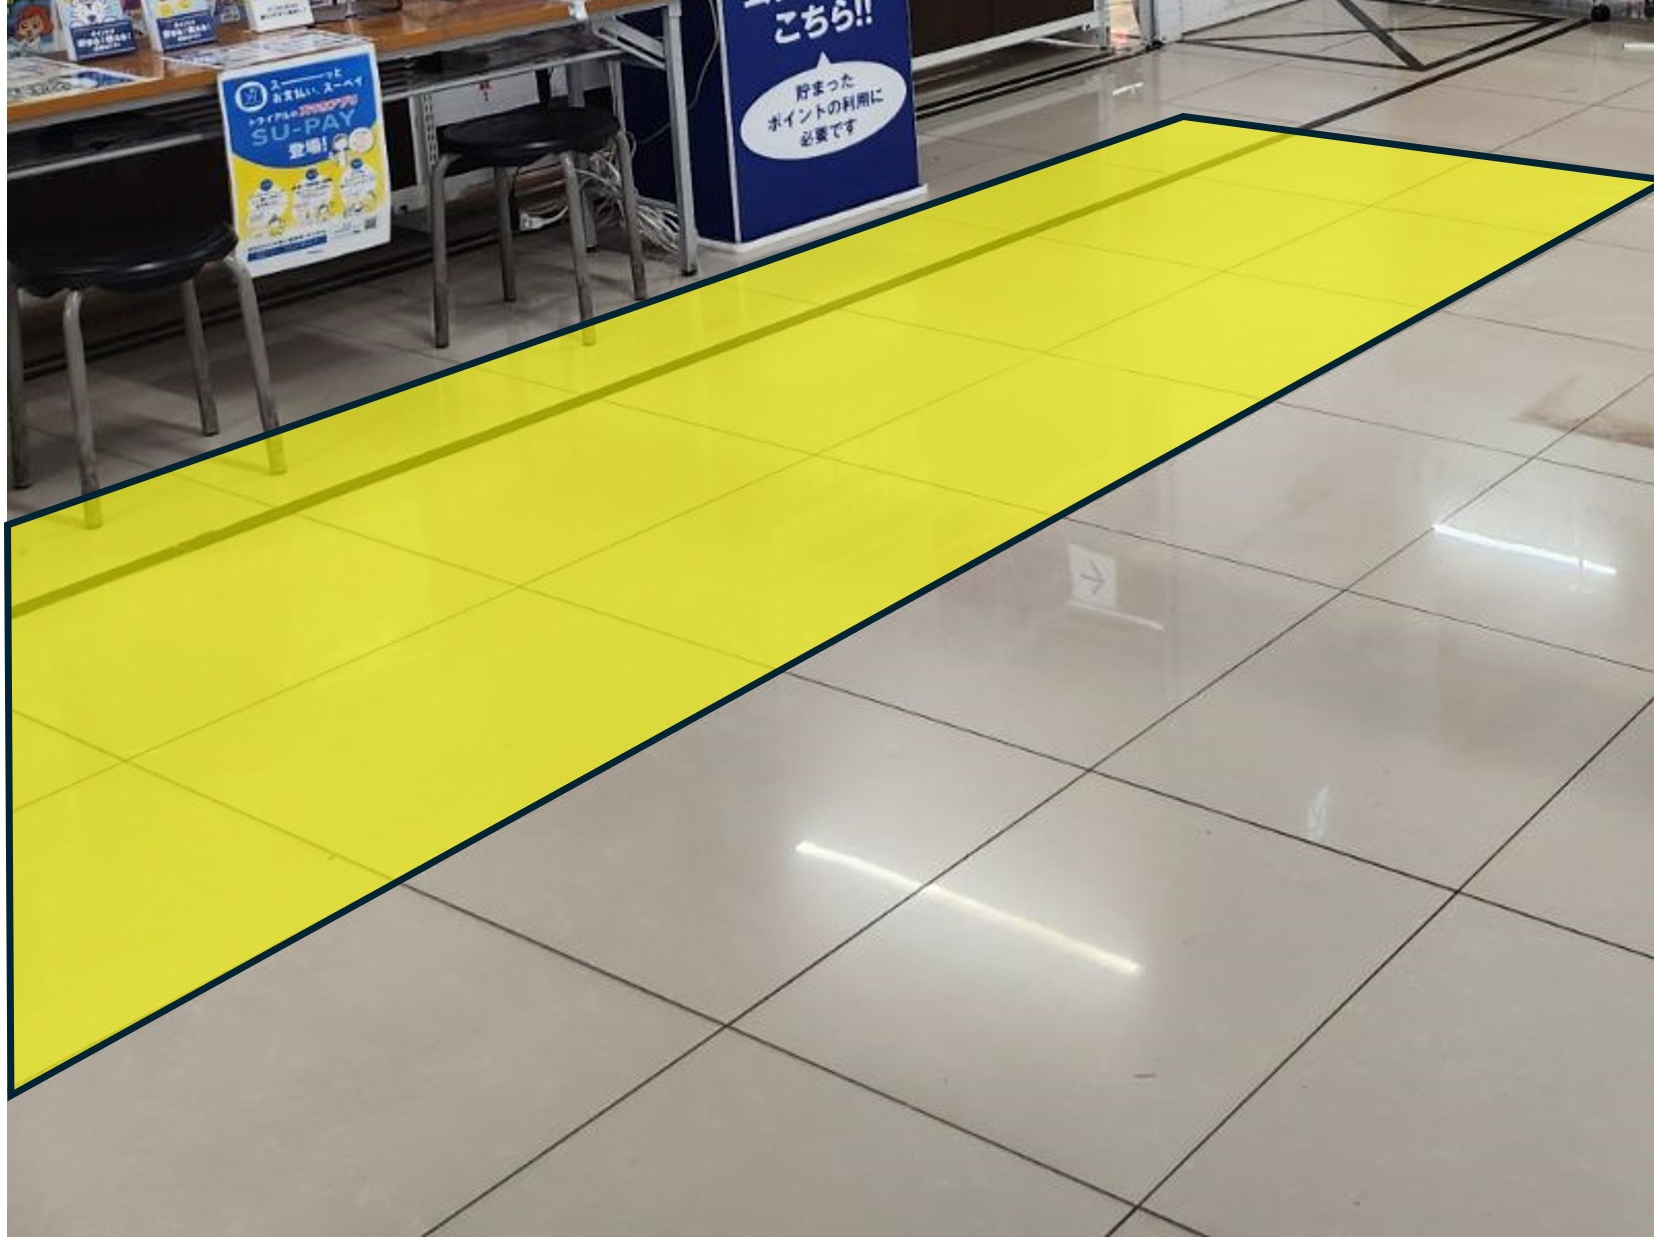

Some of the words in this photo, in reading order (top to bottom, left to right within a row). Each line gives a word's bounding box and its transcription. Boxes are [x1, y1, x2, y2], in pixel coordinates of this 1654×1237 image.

[795, 74, 856, 102] 貯まった
[767, 88, 884, 133] ポイントの利用に
[251, 109, 356, 147] SU-PAY
[799, 118, 858, 147] 必要です
